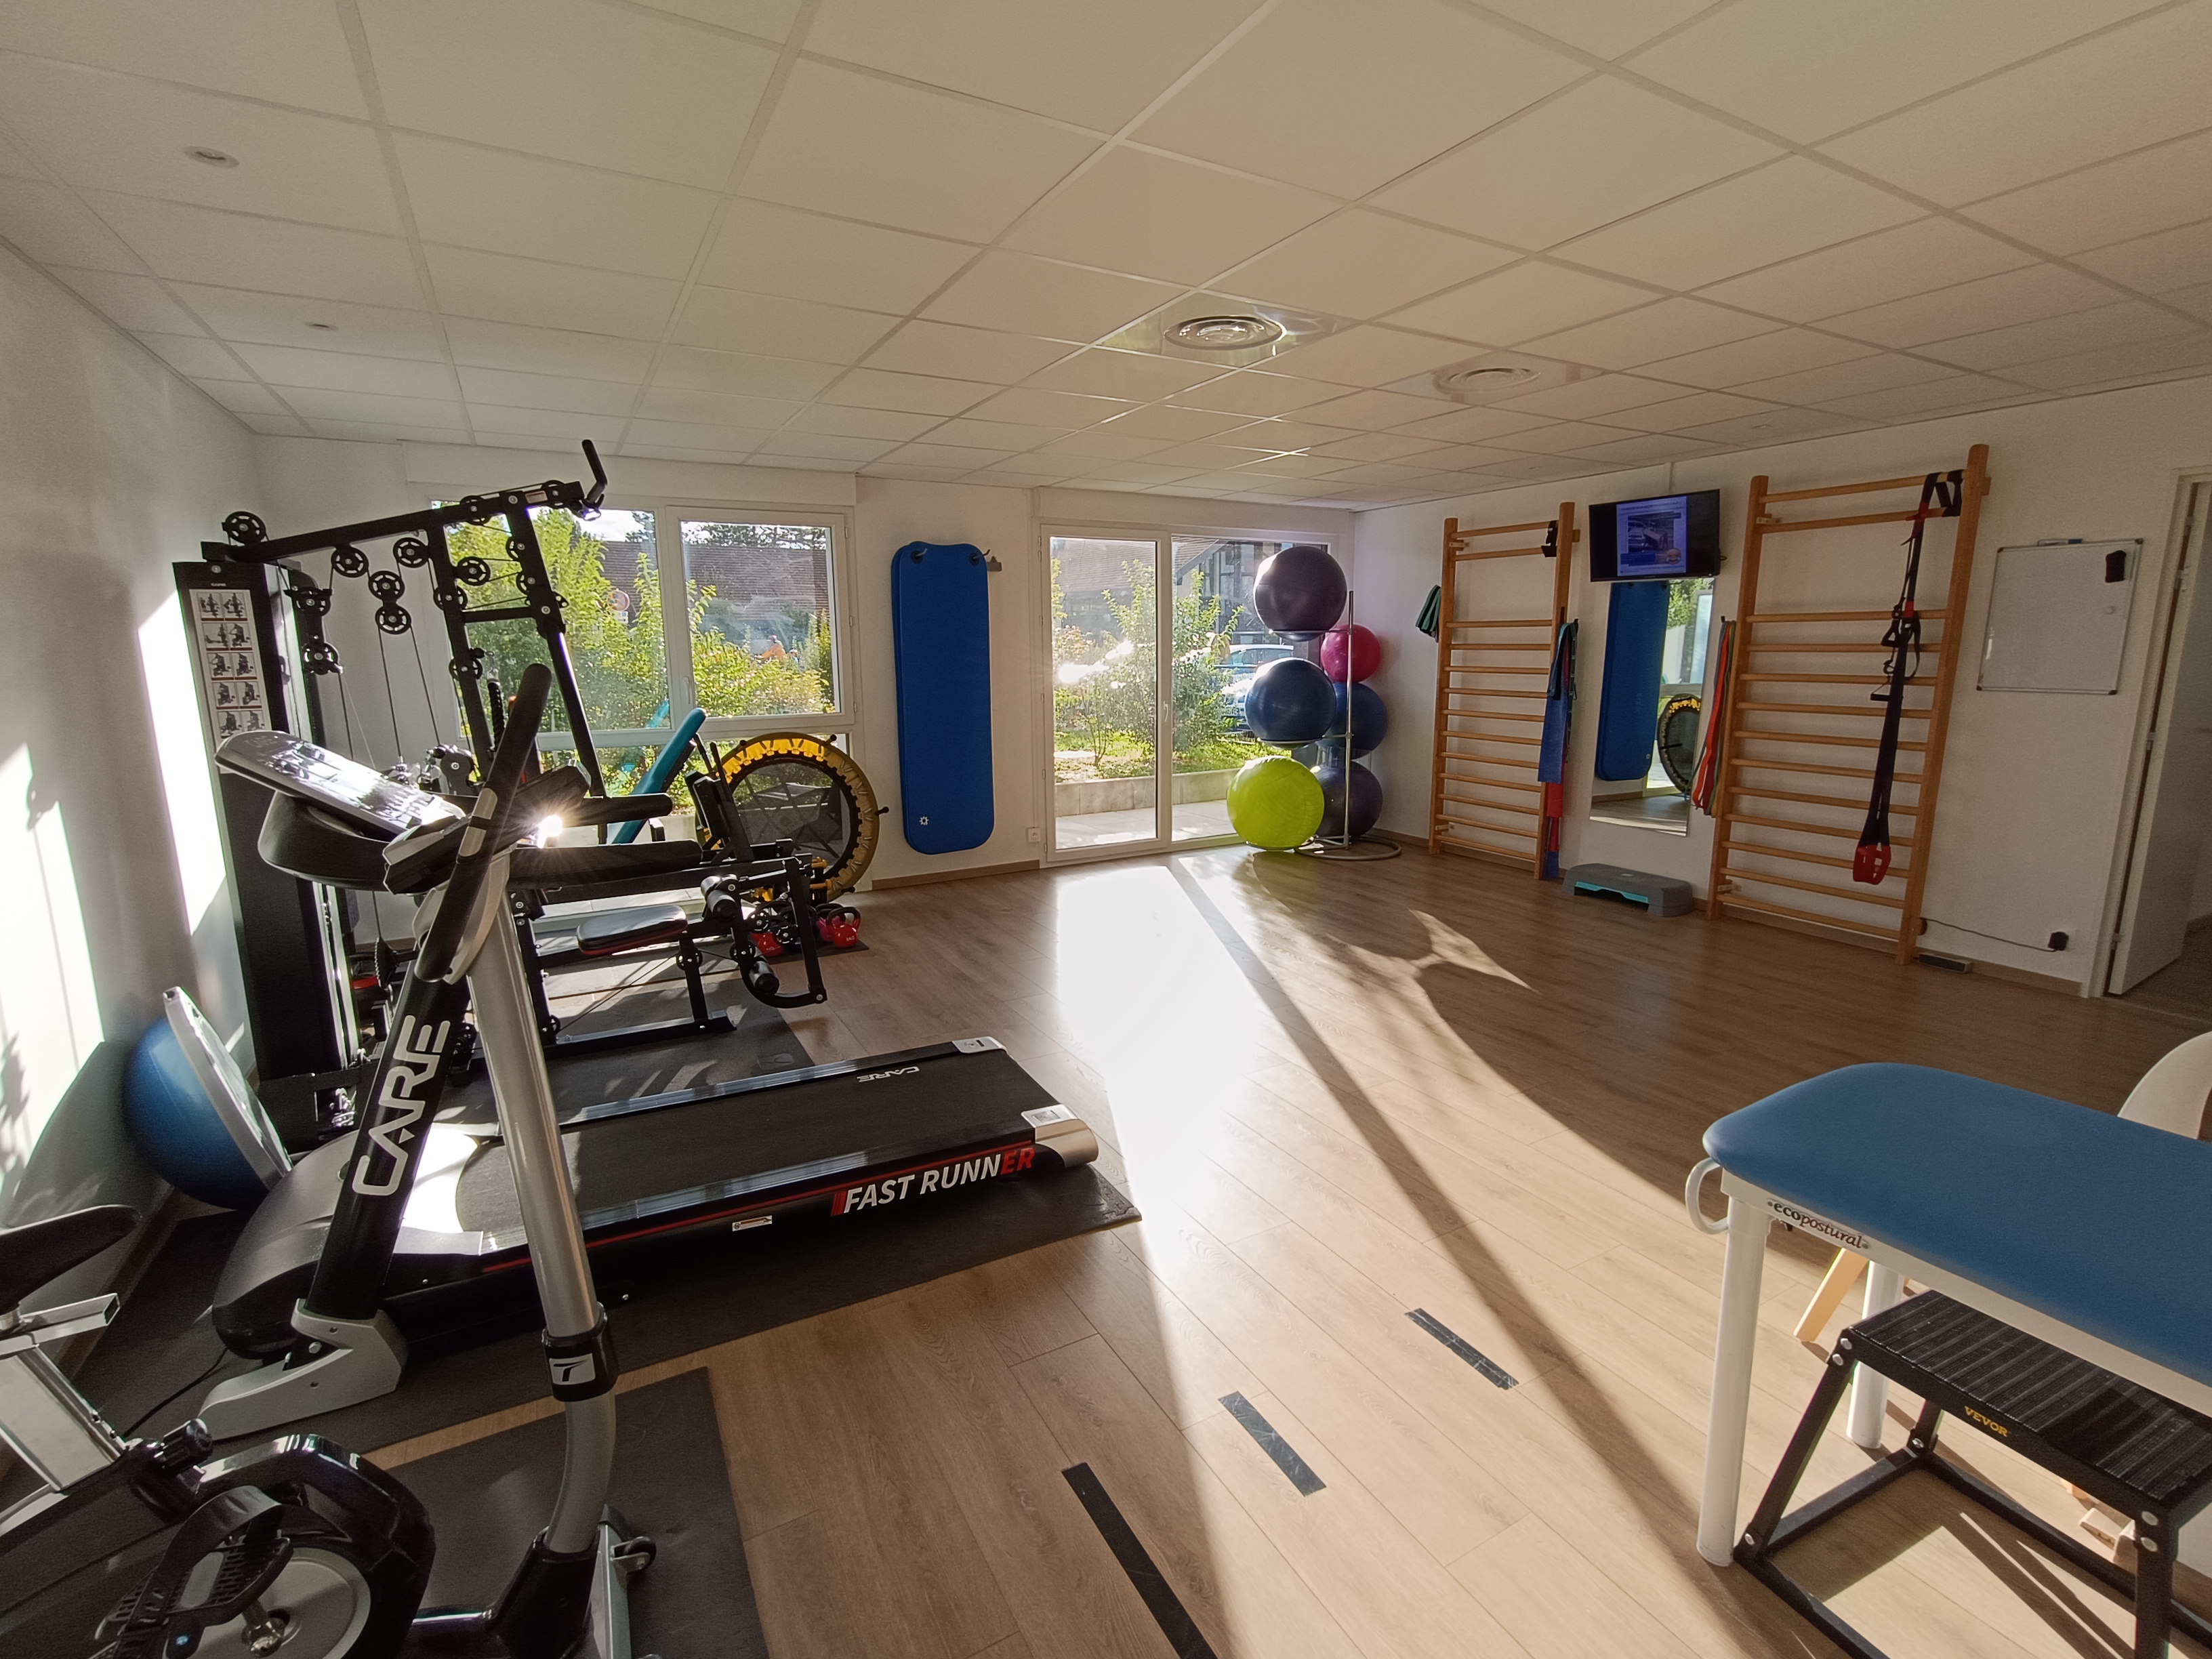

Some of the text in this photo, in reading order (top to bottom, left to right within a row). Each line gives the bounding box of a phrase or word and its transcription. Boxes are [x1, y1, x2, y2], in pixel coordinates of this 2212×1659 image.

[857, 1067, 920, 1082] CARE
[352, 1015, 451, 1195] CARE
[844, 1147, 1036, 1214] FAST RUNNER
[1773, 1202, 1863, 1248] ecopostural
[1964, 1406, 2008, 1437] VEVOR
